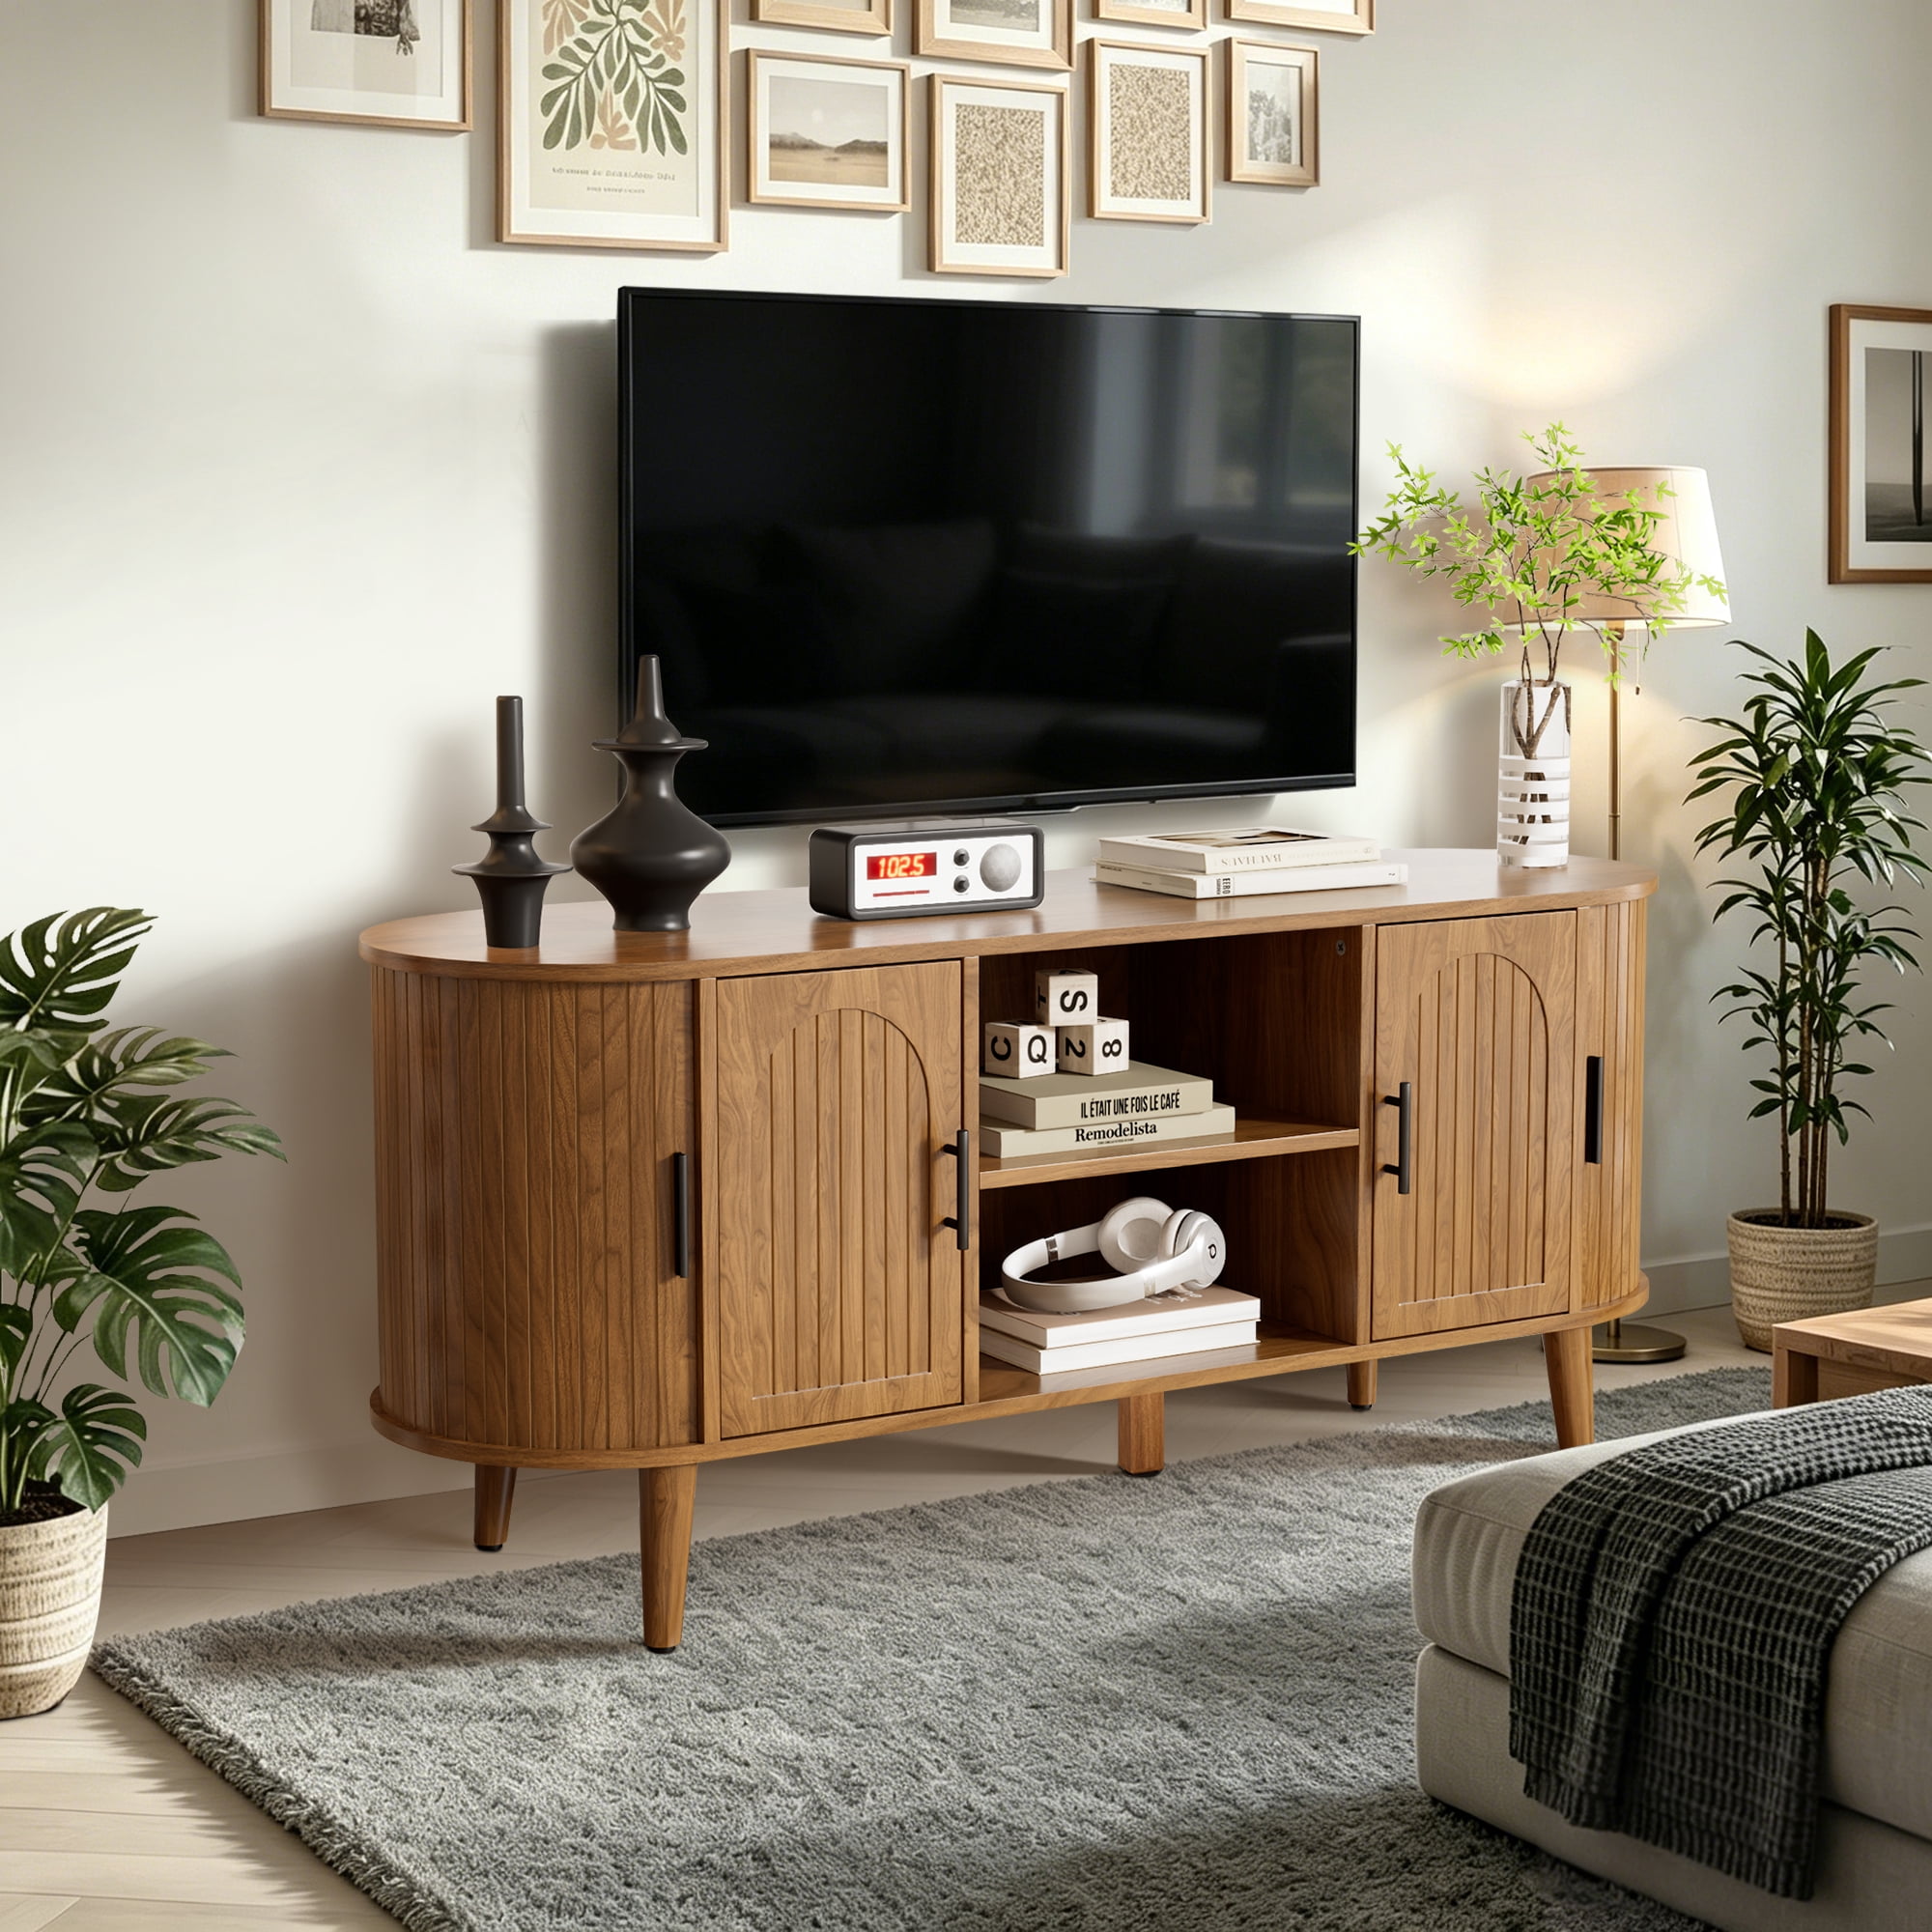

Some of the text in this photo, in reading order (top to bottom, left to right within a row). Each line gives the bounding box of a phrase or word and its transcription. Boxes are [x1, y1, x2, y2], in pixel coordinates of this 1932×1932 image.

[878, 854, 925, 878] 102.5
[1060, 989, 1088, 1012] S
[990, 1036, 1011, 1061] C
[1027, 1035, 1047, 1064] Q
[1065, 1037, 1086, 1058] 2
[1102, 1038, 1122, 1058] 8
[1081, 1089, 1180, 1119] IL ÉTAIT UNE FOIS LE CAFÉ
[1075, 1122, 1157, 1142] Remodelista
